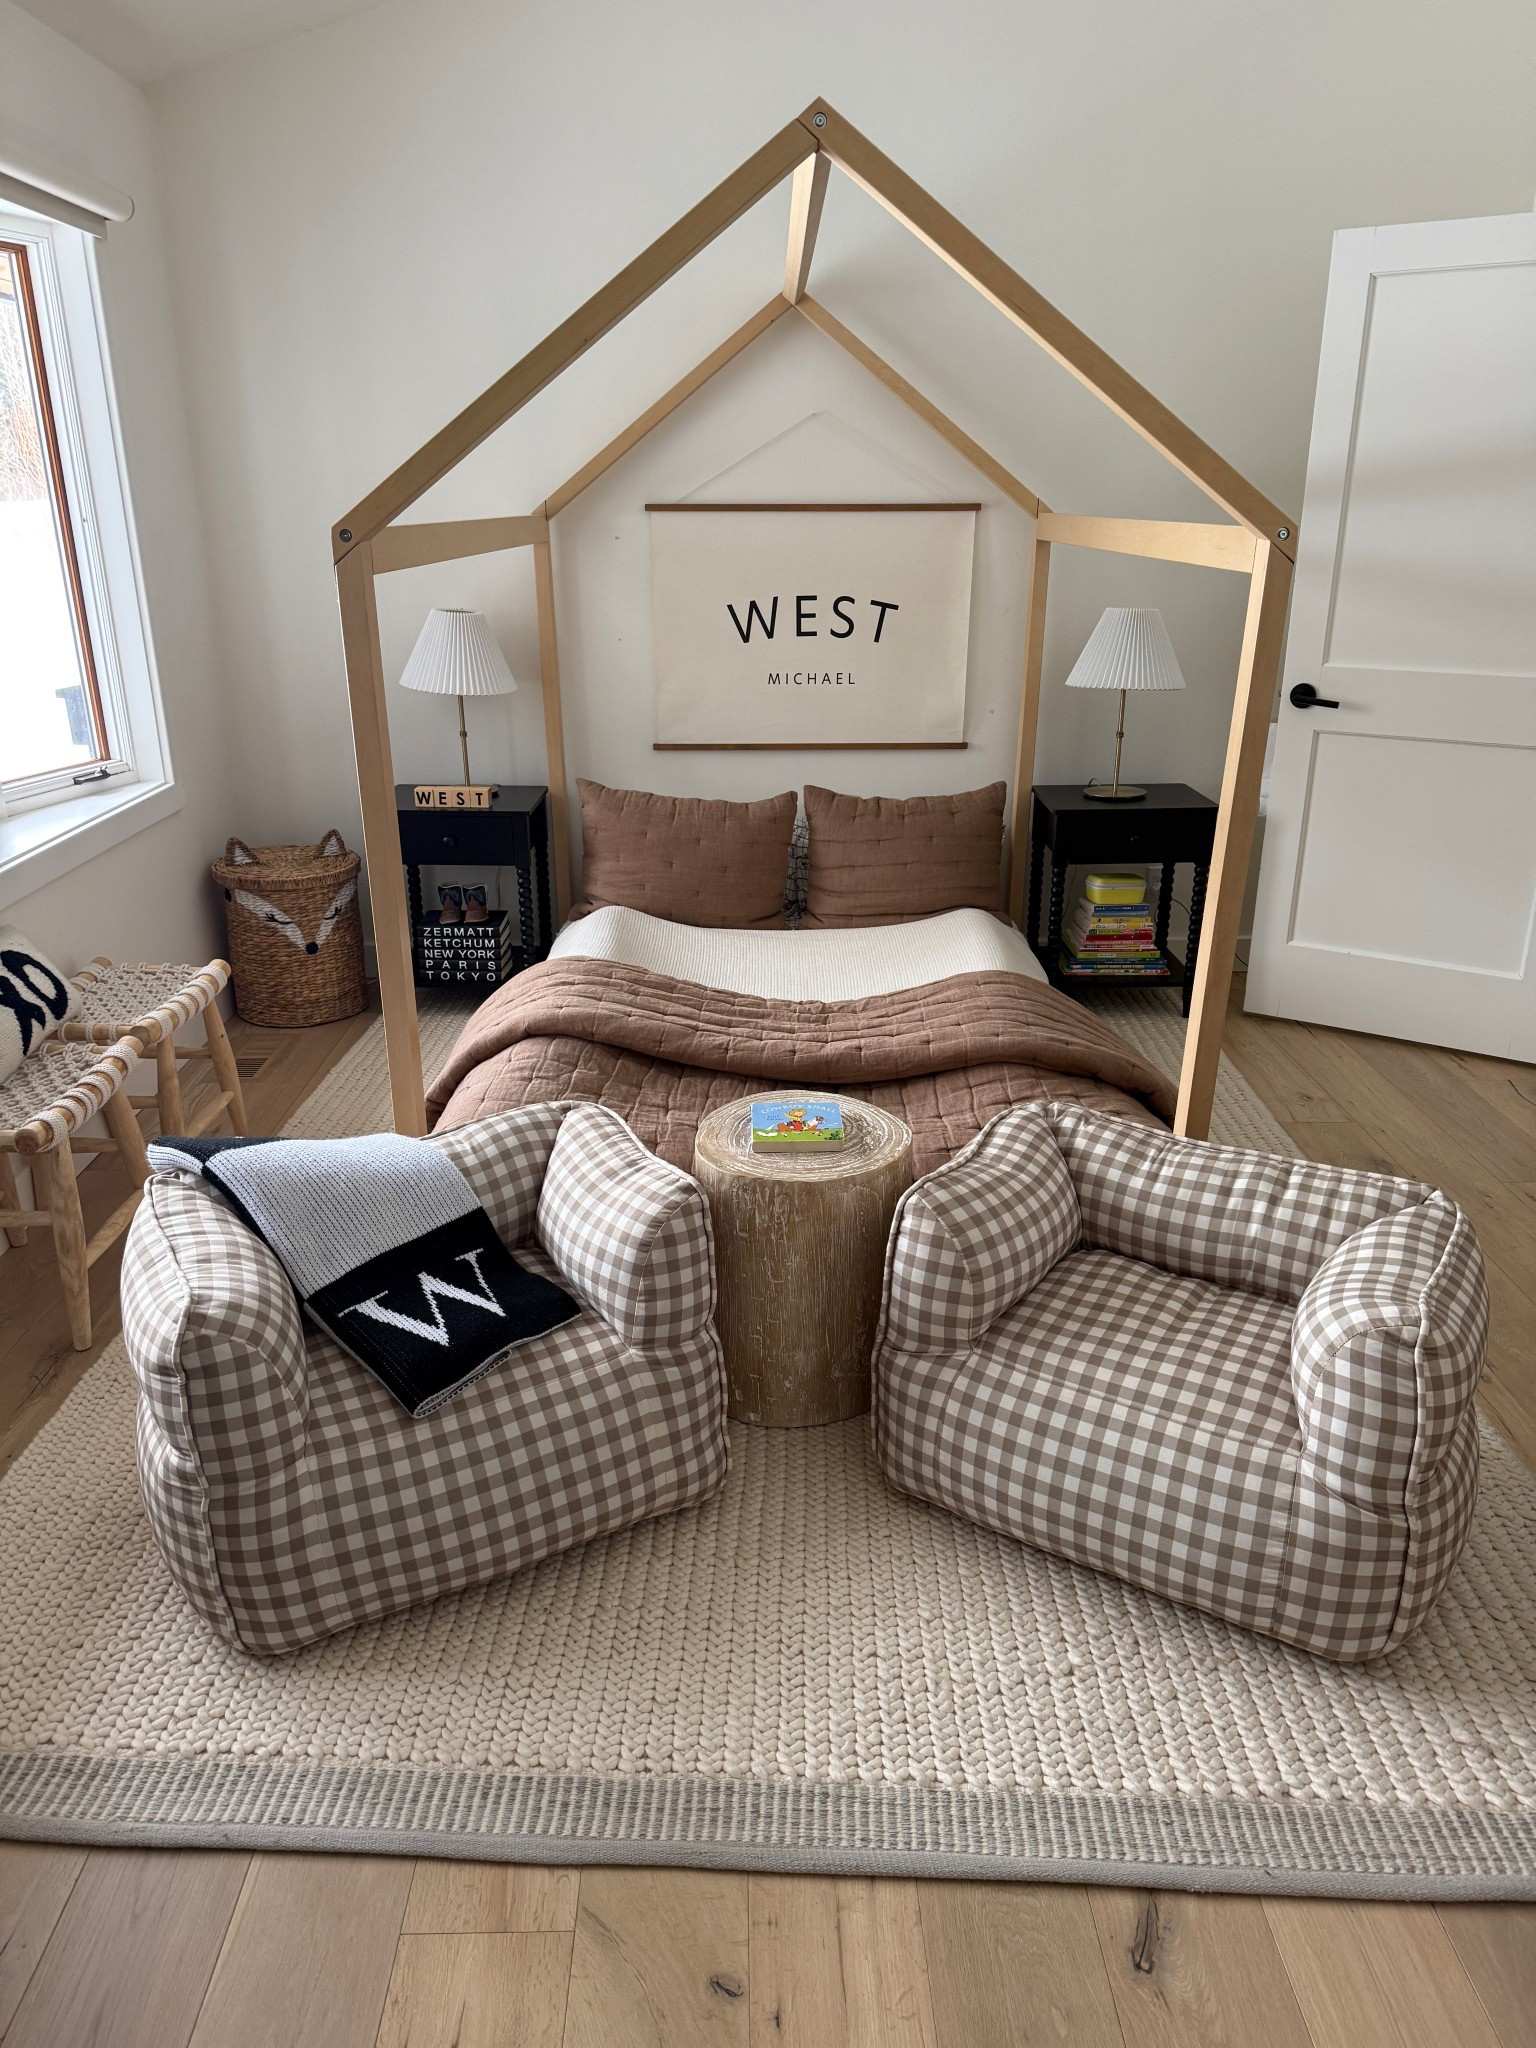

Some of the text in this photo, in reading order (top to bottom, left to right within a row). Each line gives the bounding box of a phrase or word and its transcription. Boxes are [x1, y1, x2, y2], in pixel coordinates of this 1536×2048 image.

[726, 595, 899, 644] WEST
[767, 672, 855, 685] MICHAEL
[415, 791, 484, 806] WEST
[423, 927, 494, 937] ZERMATT
[423, 938, 496, 948] KETCHUM
[424, 949, 496, 960] NEW YORK
[426, 960, 496, 970] PARIS
[426, 970, 497, 982] TOKYO
[761, 1104, 837, 1114] COWBOY SMALL
[337, 1247, 507, 1348] W
